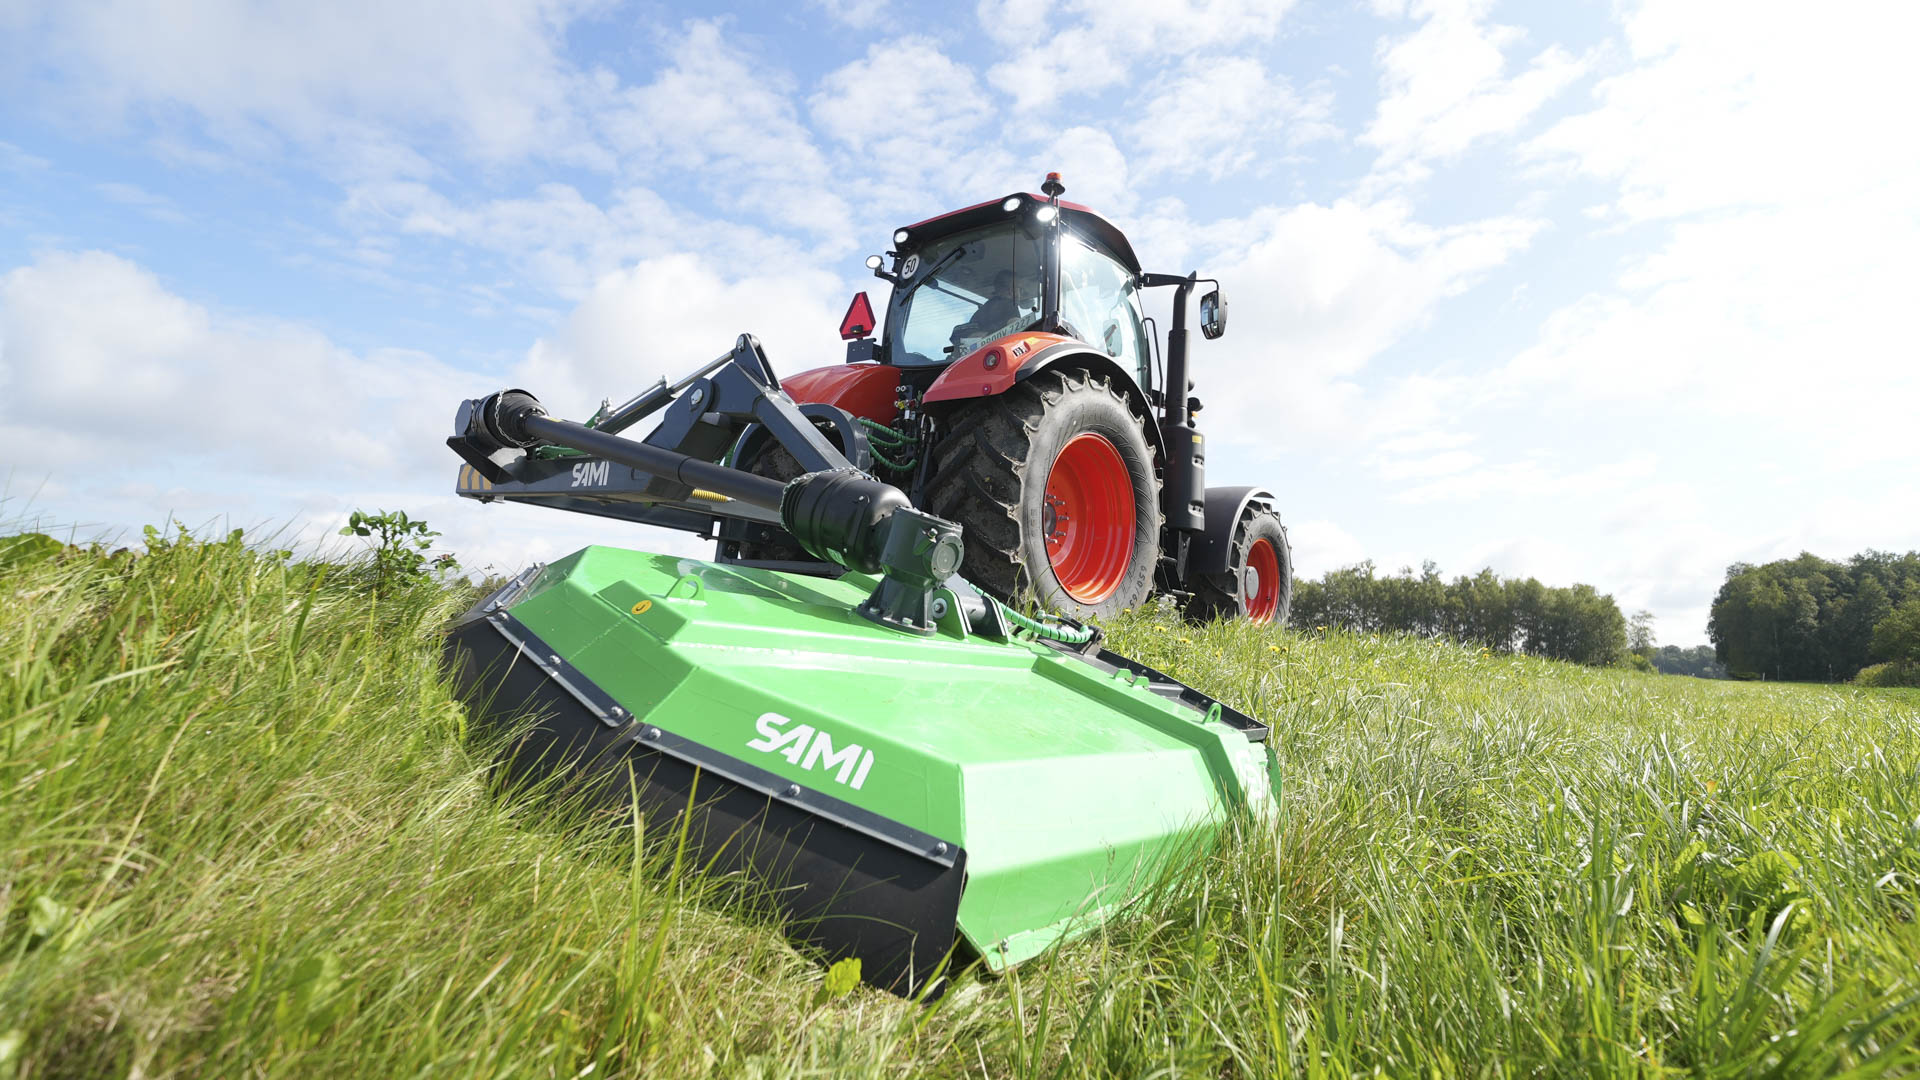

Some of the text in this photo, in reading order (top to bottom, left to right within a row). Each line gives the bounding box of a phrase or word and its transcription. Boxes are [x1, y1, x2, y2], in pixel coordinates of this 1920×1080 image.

[904, 257, 917, 275] 50
[571, 461, 609, 487] SAMI
[1129, 565, 1147, 609] 650/65
[745, 712, 875, 790] SAMI
